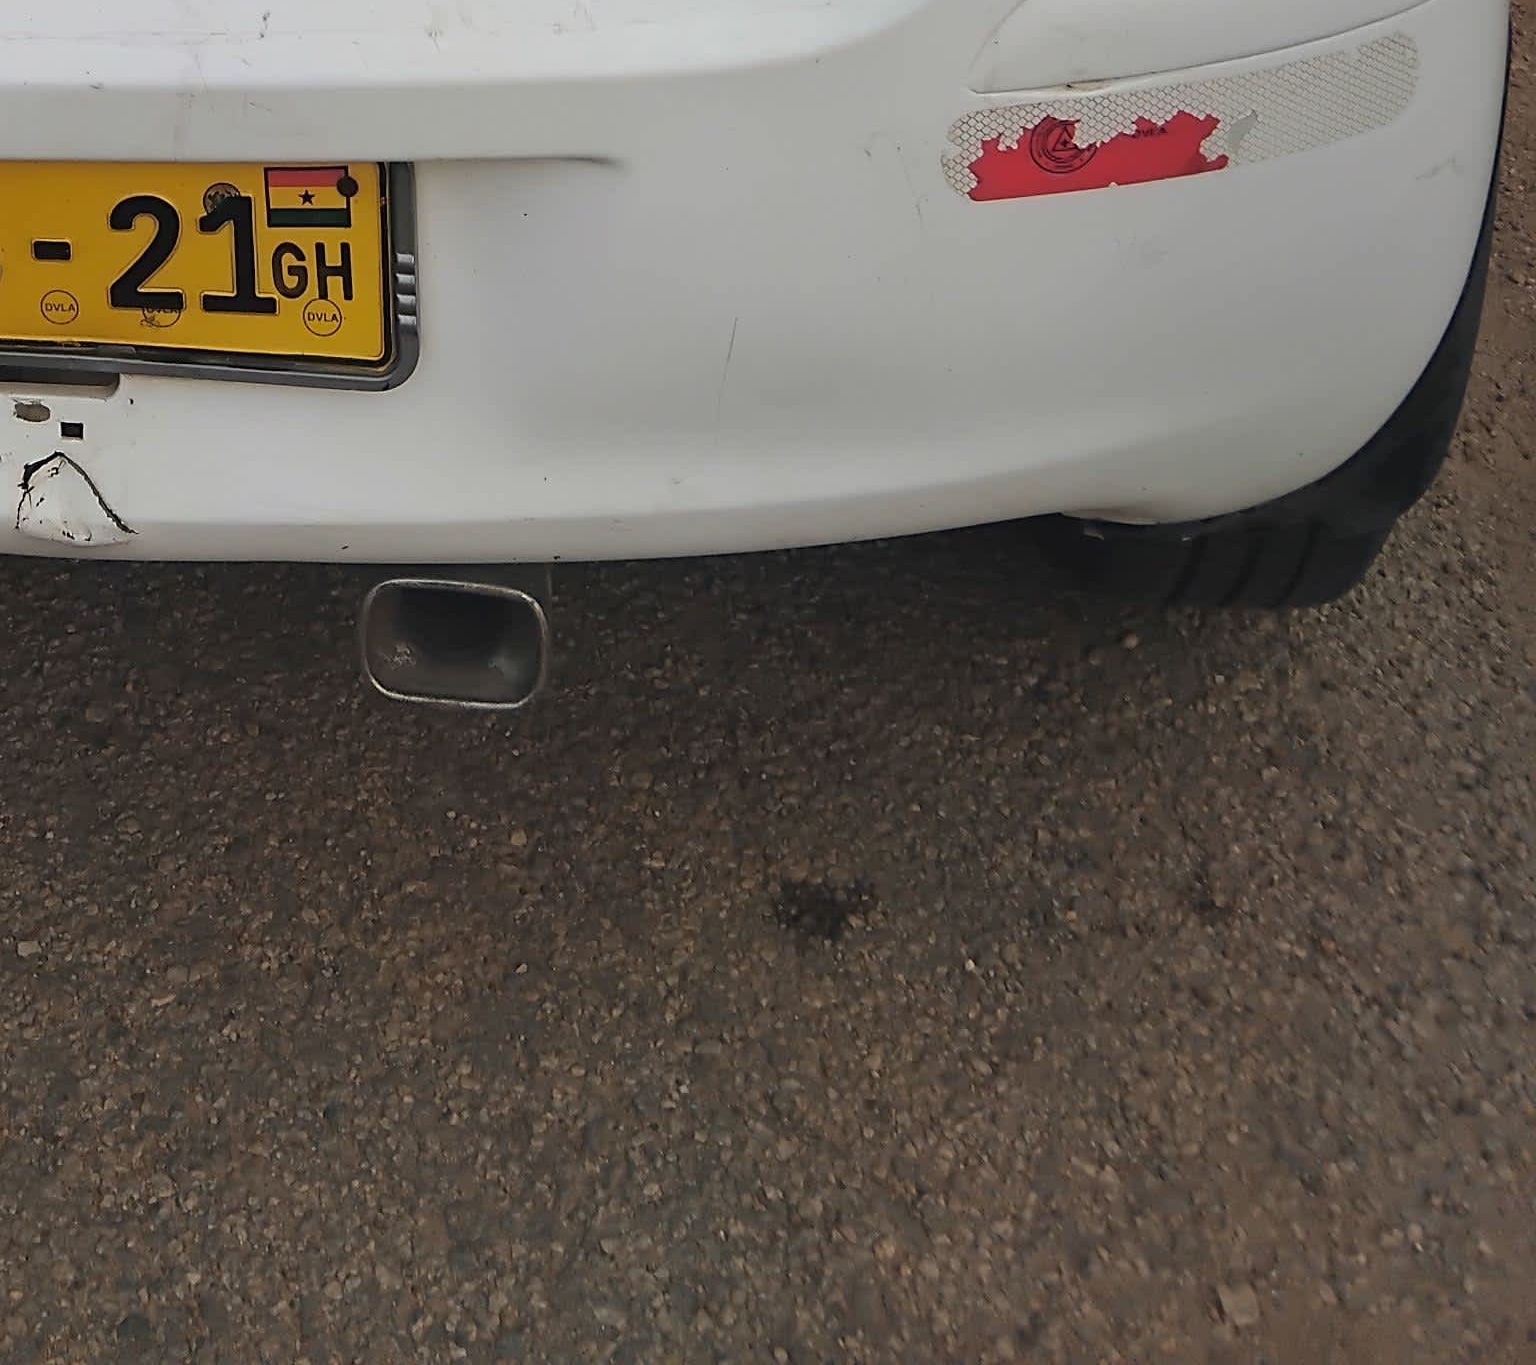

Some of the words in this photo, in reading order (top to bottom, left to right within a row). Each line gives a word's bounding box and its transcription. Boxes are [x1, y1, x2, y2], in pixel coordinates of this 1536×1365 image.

[271, 241, 353, 301] GH
[45, 303, 76, 313] DVLA
[307, 312, 339, 323] DVLA
